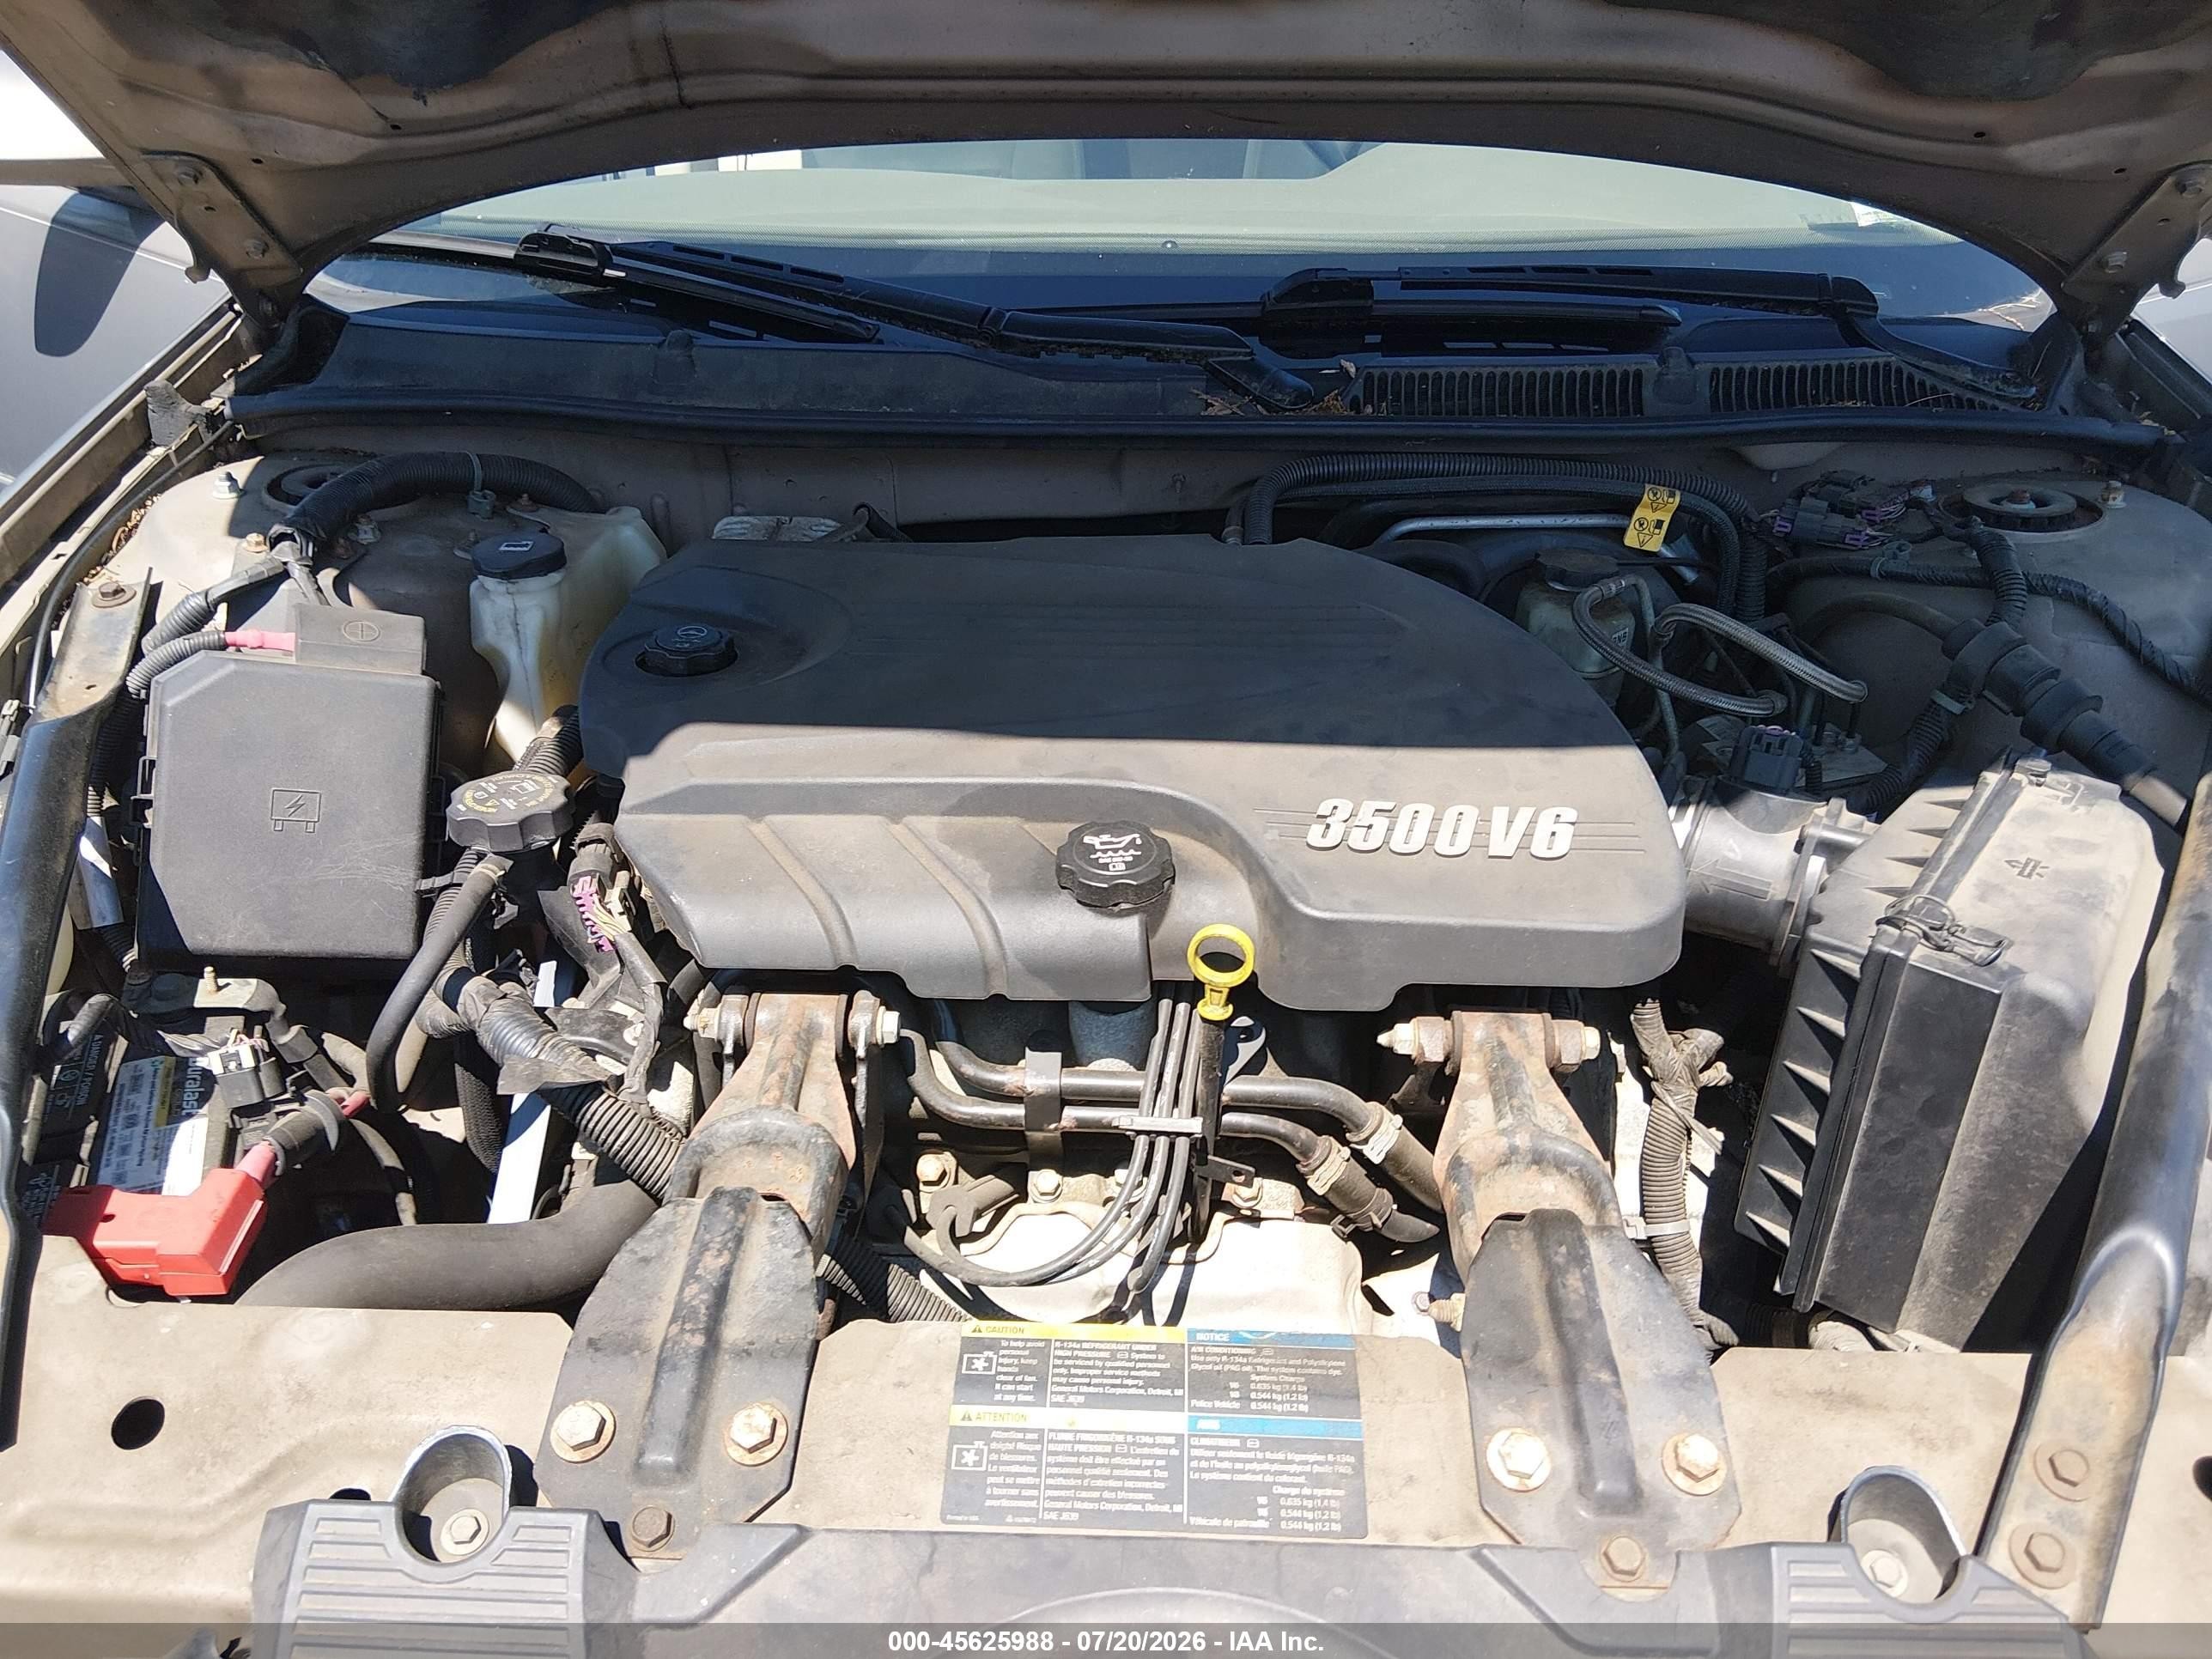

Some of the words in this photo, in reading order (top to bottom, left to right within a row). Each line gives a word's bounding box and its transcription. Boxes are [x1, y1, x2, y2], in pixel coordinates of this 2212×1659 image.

[1305, 798, 1480, 858] 3500
[1488, 806, 1578, 860] V6
[1196, 1333, 1230, 1341] NOTICE
[1273, 1393, 1282, 1401] kg
[975, 1413, 1026, 1422] ATTENTION
